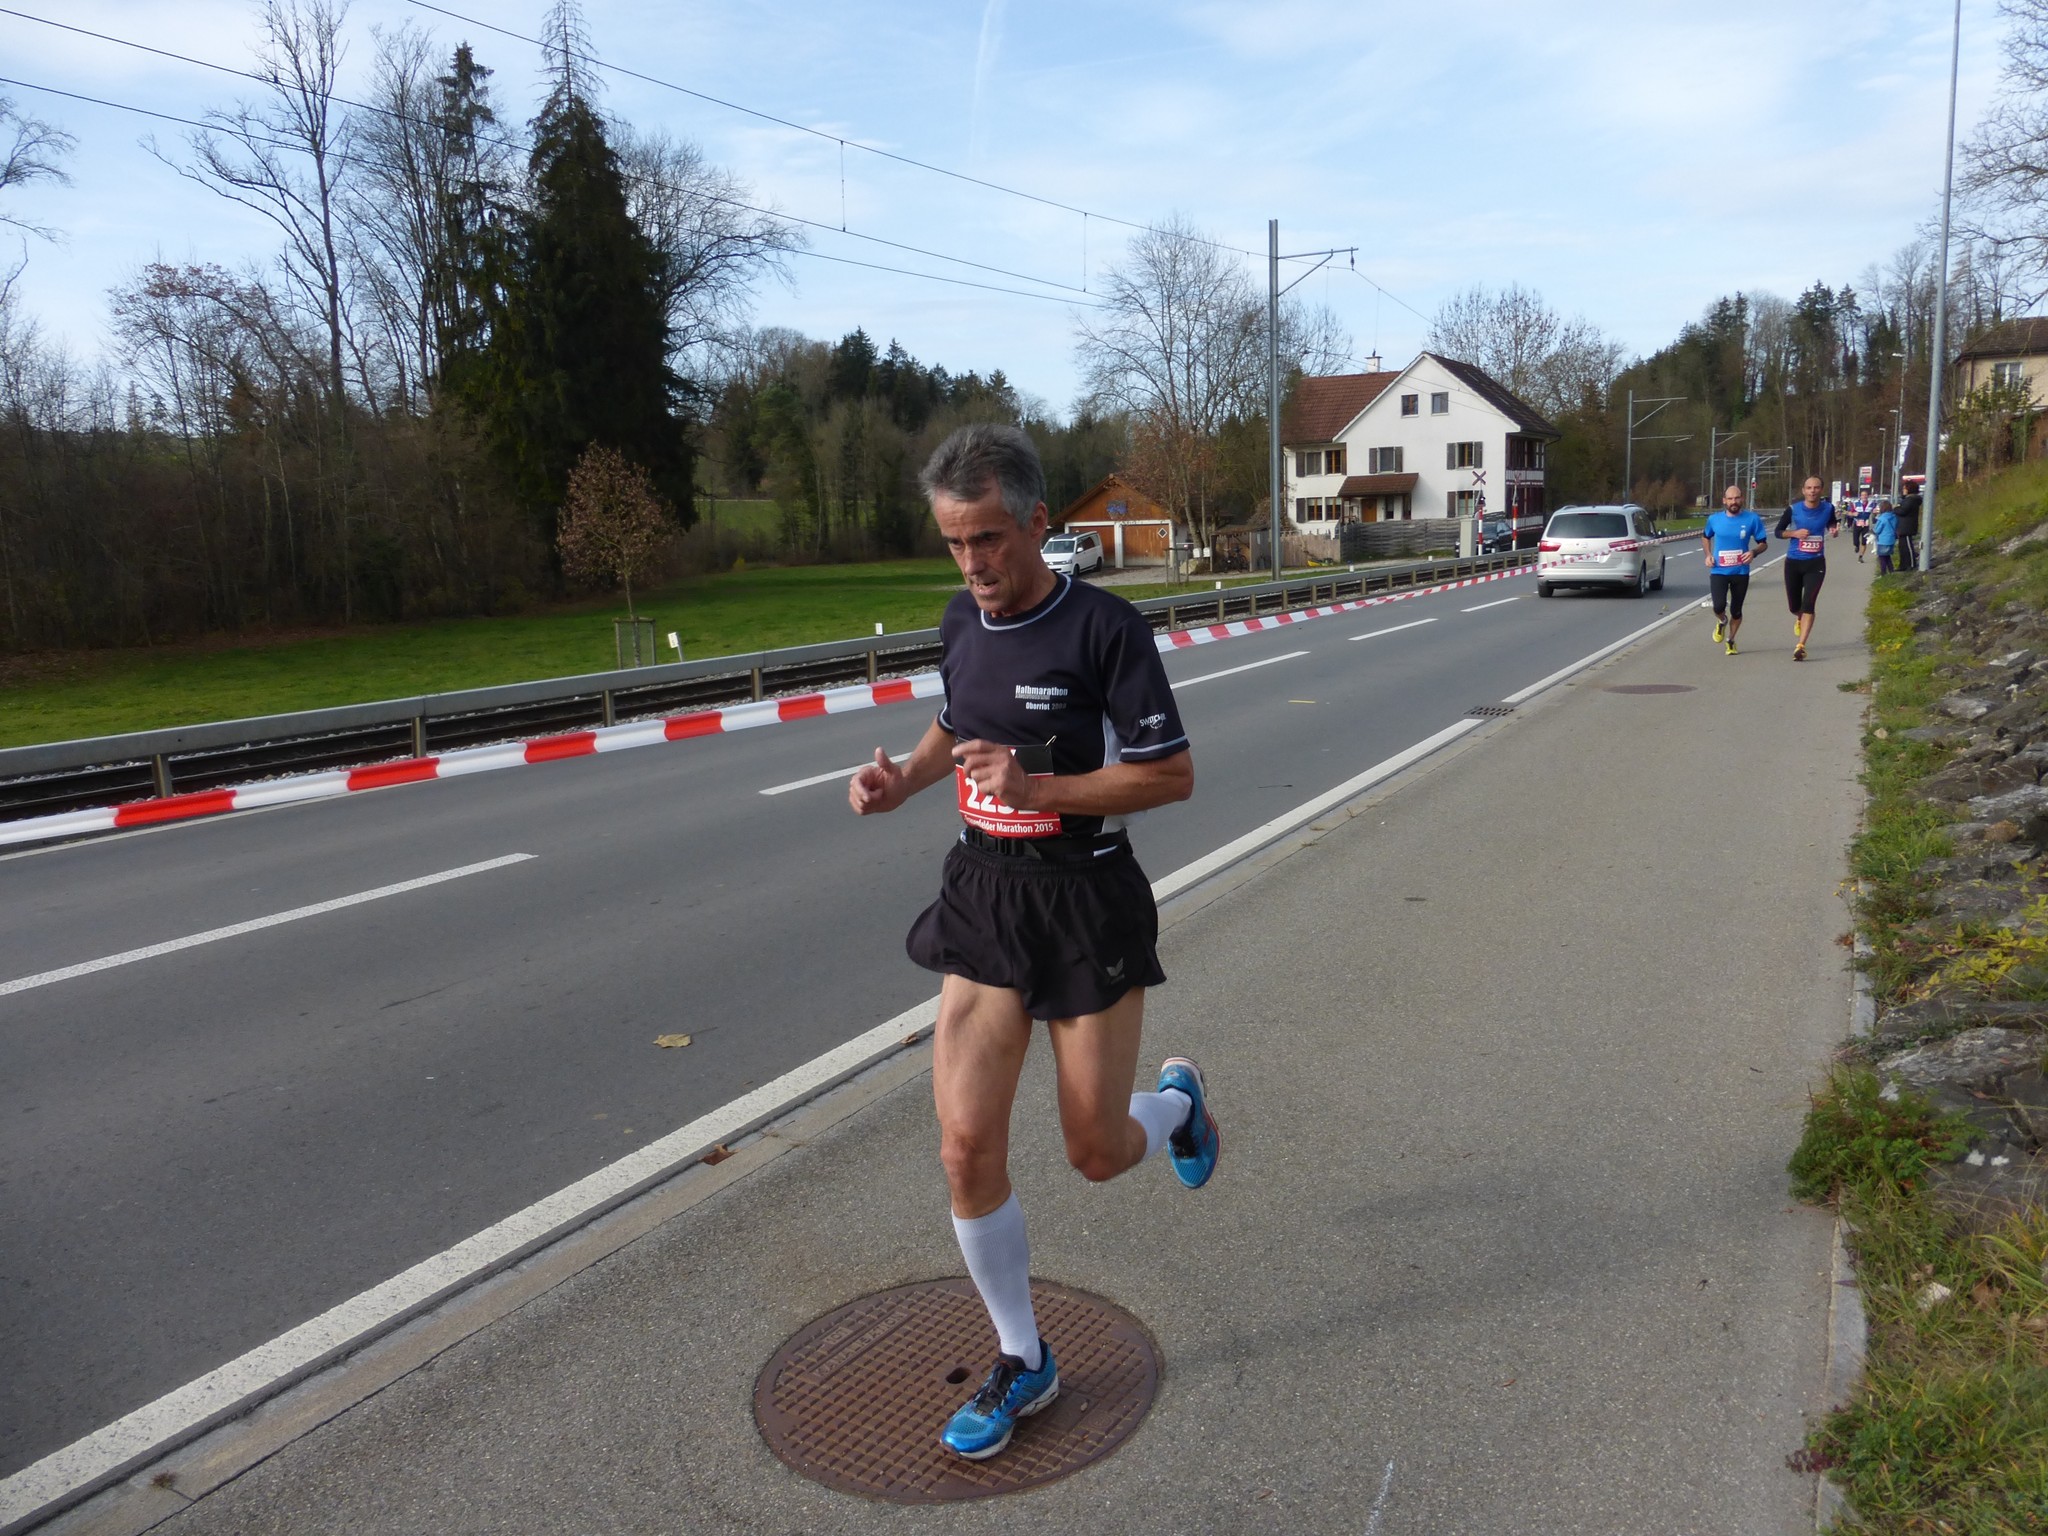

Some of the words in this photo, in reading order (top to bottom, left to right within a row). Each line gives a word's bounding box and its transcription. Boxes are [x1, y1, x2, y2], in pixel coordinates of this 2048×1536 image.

[1015, 684, 1069, 696] Halbmarathon
[964, 776, 1040, 815] 22
[996, 822, 1033, 833] Marathon
[1034, 822, 1054, 832] 2015
